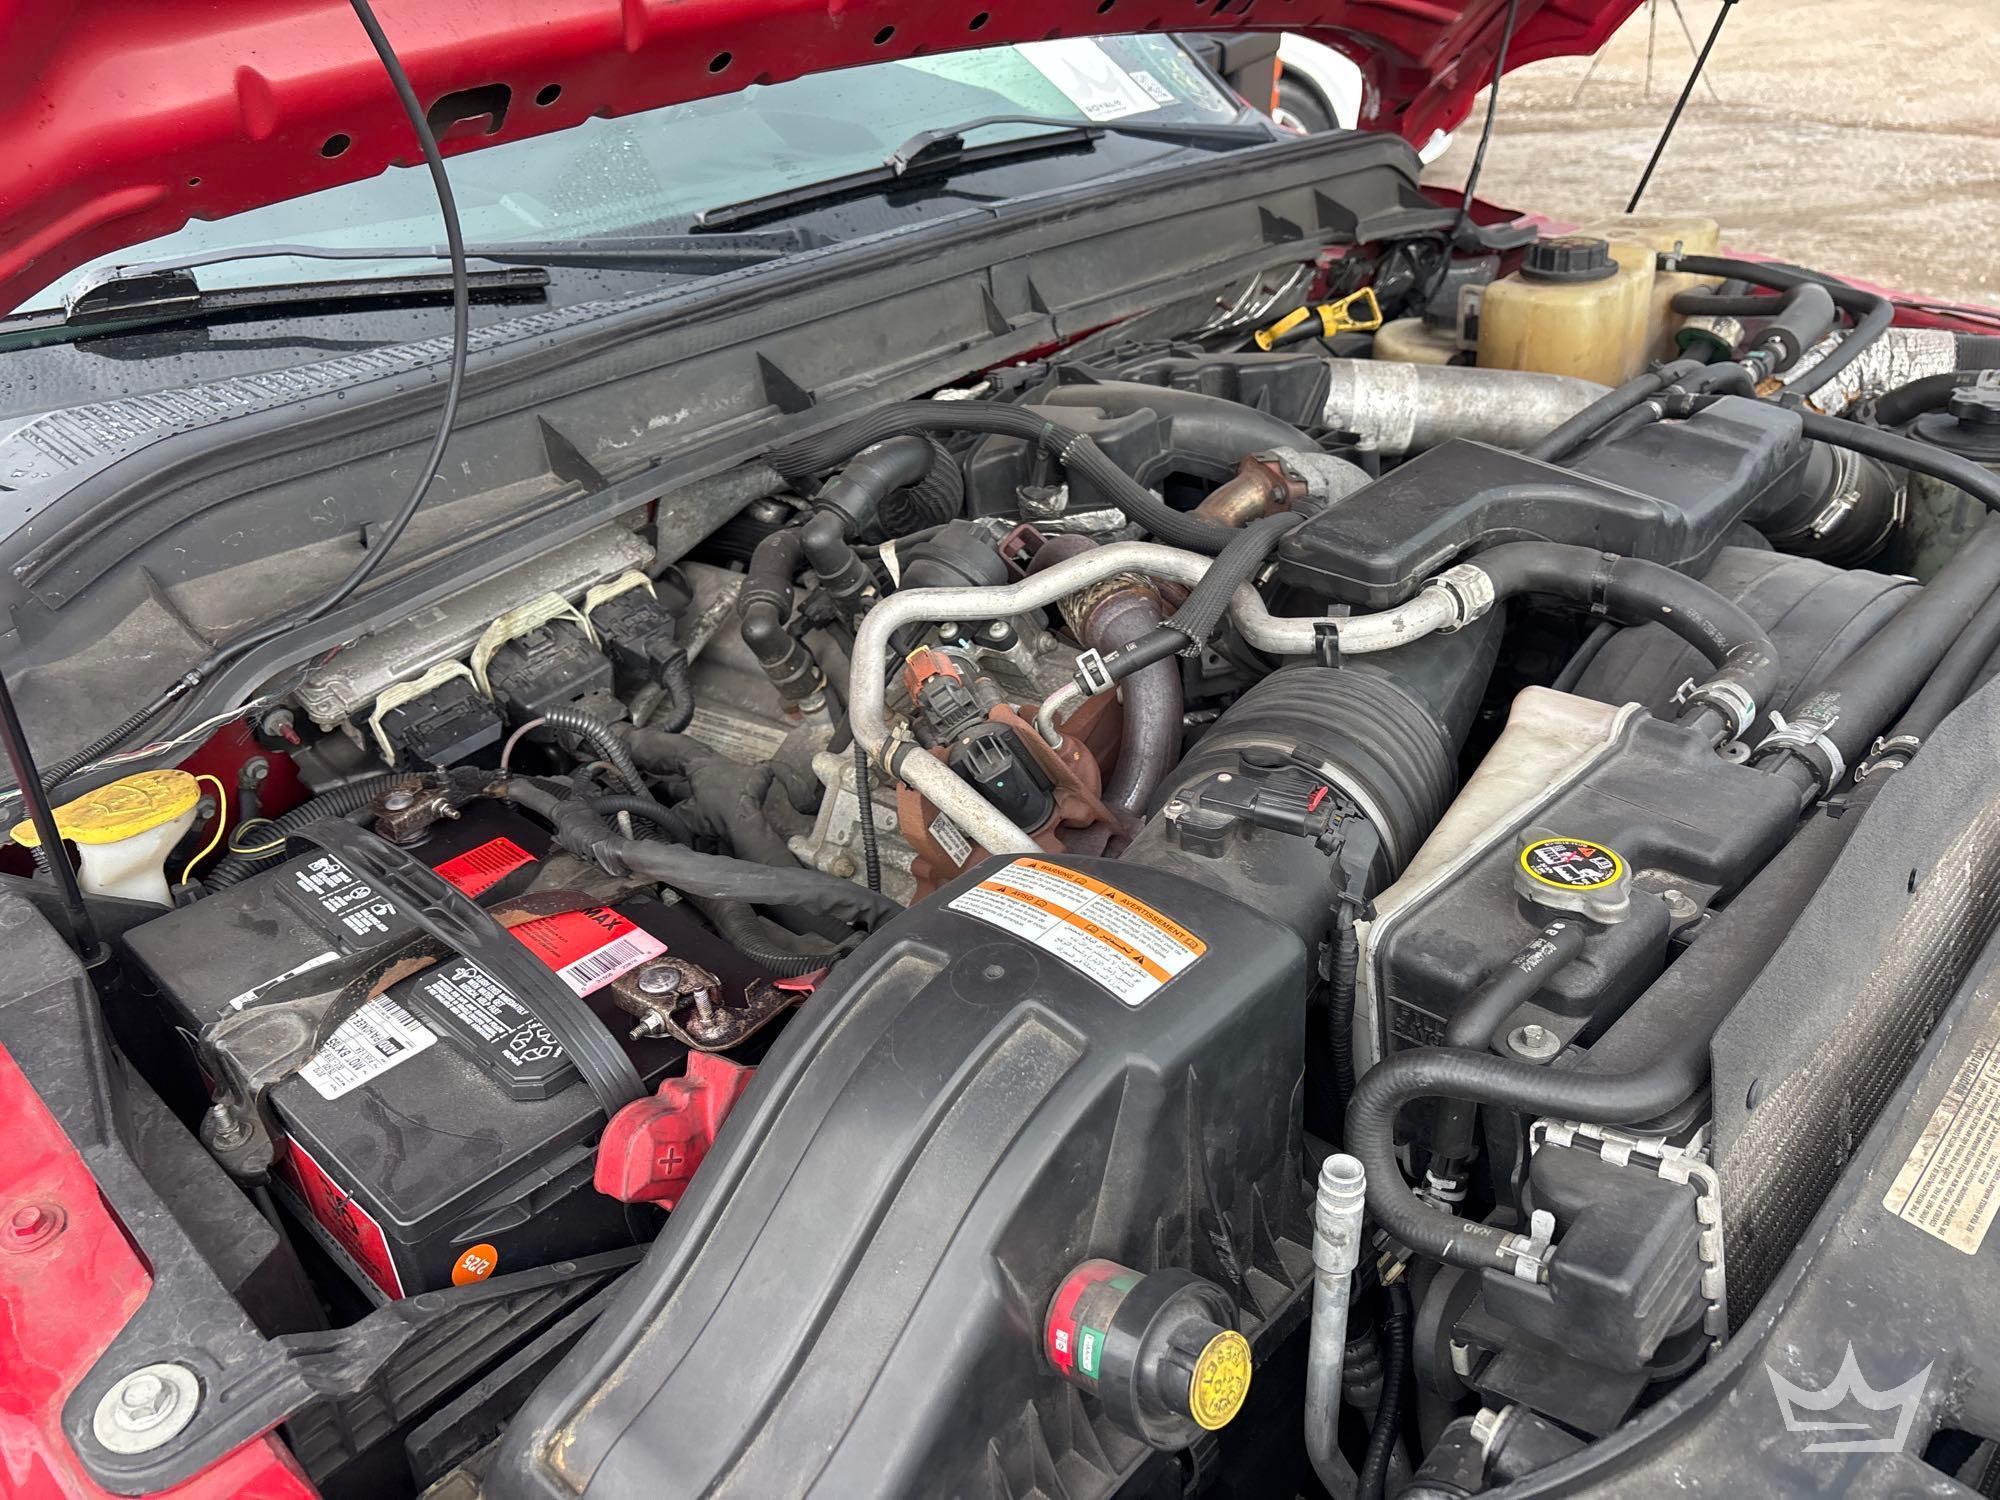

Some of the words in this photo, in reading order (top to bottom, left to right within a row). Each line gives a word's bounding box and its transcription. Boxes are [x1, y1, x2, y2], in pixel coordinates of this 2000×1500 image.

[1040, 864, 1073, 880] WARNING
[1011, 889, 1034, 902] AVISO
[1120, 897, 1187, 939] AVERTISSEMENT
[462, 1253, 490, 1276] 2/25
